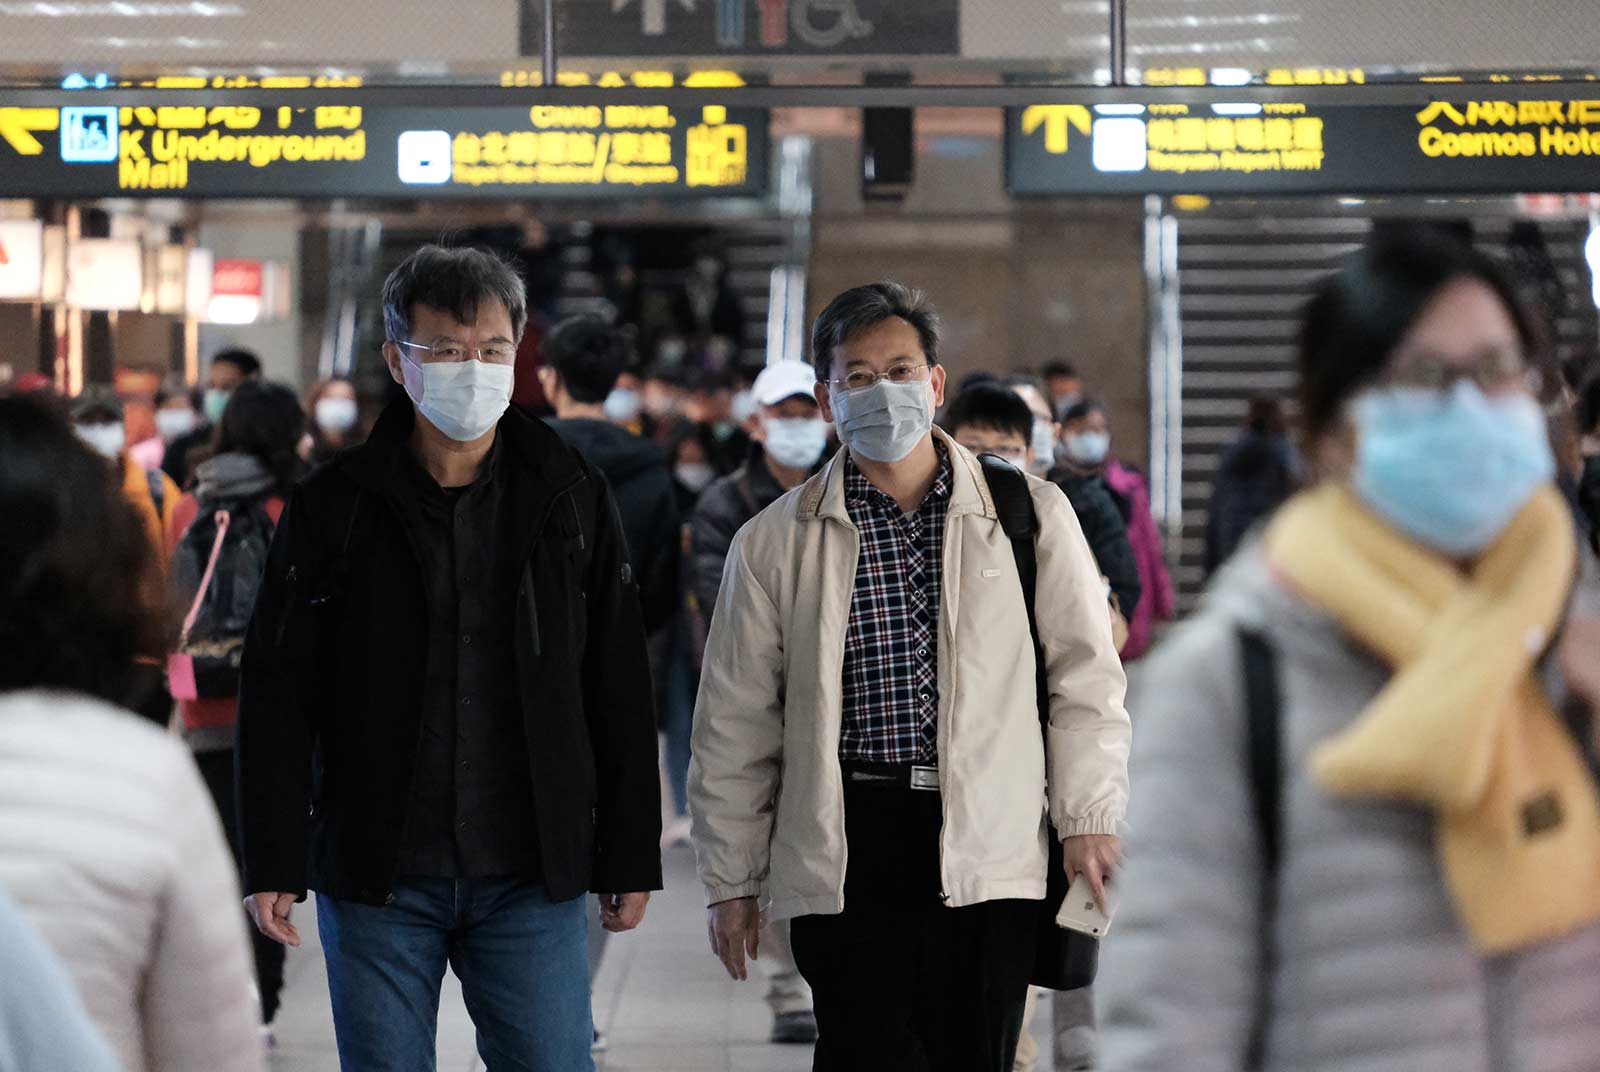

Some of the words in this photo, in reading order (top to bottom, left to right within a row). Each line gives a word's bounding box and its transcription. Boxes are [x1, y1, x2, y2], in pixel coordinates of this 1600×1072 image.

[118, 130, 145, 160] K
[152, 130, 366, 167] Underground
[1418, 126, 1536, 157] Cosmos
[118, 158, 188, 189] Mall
